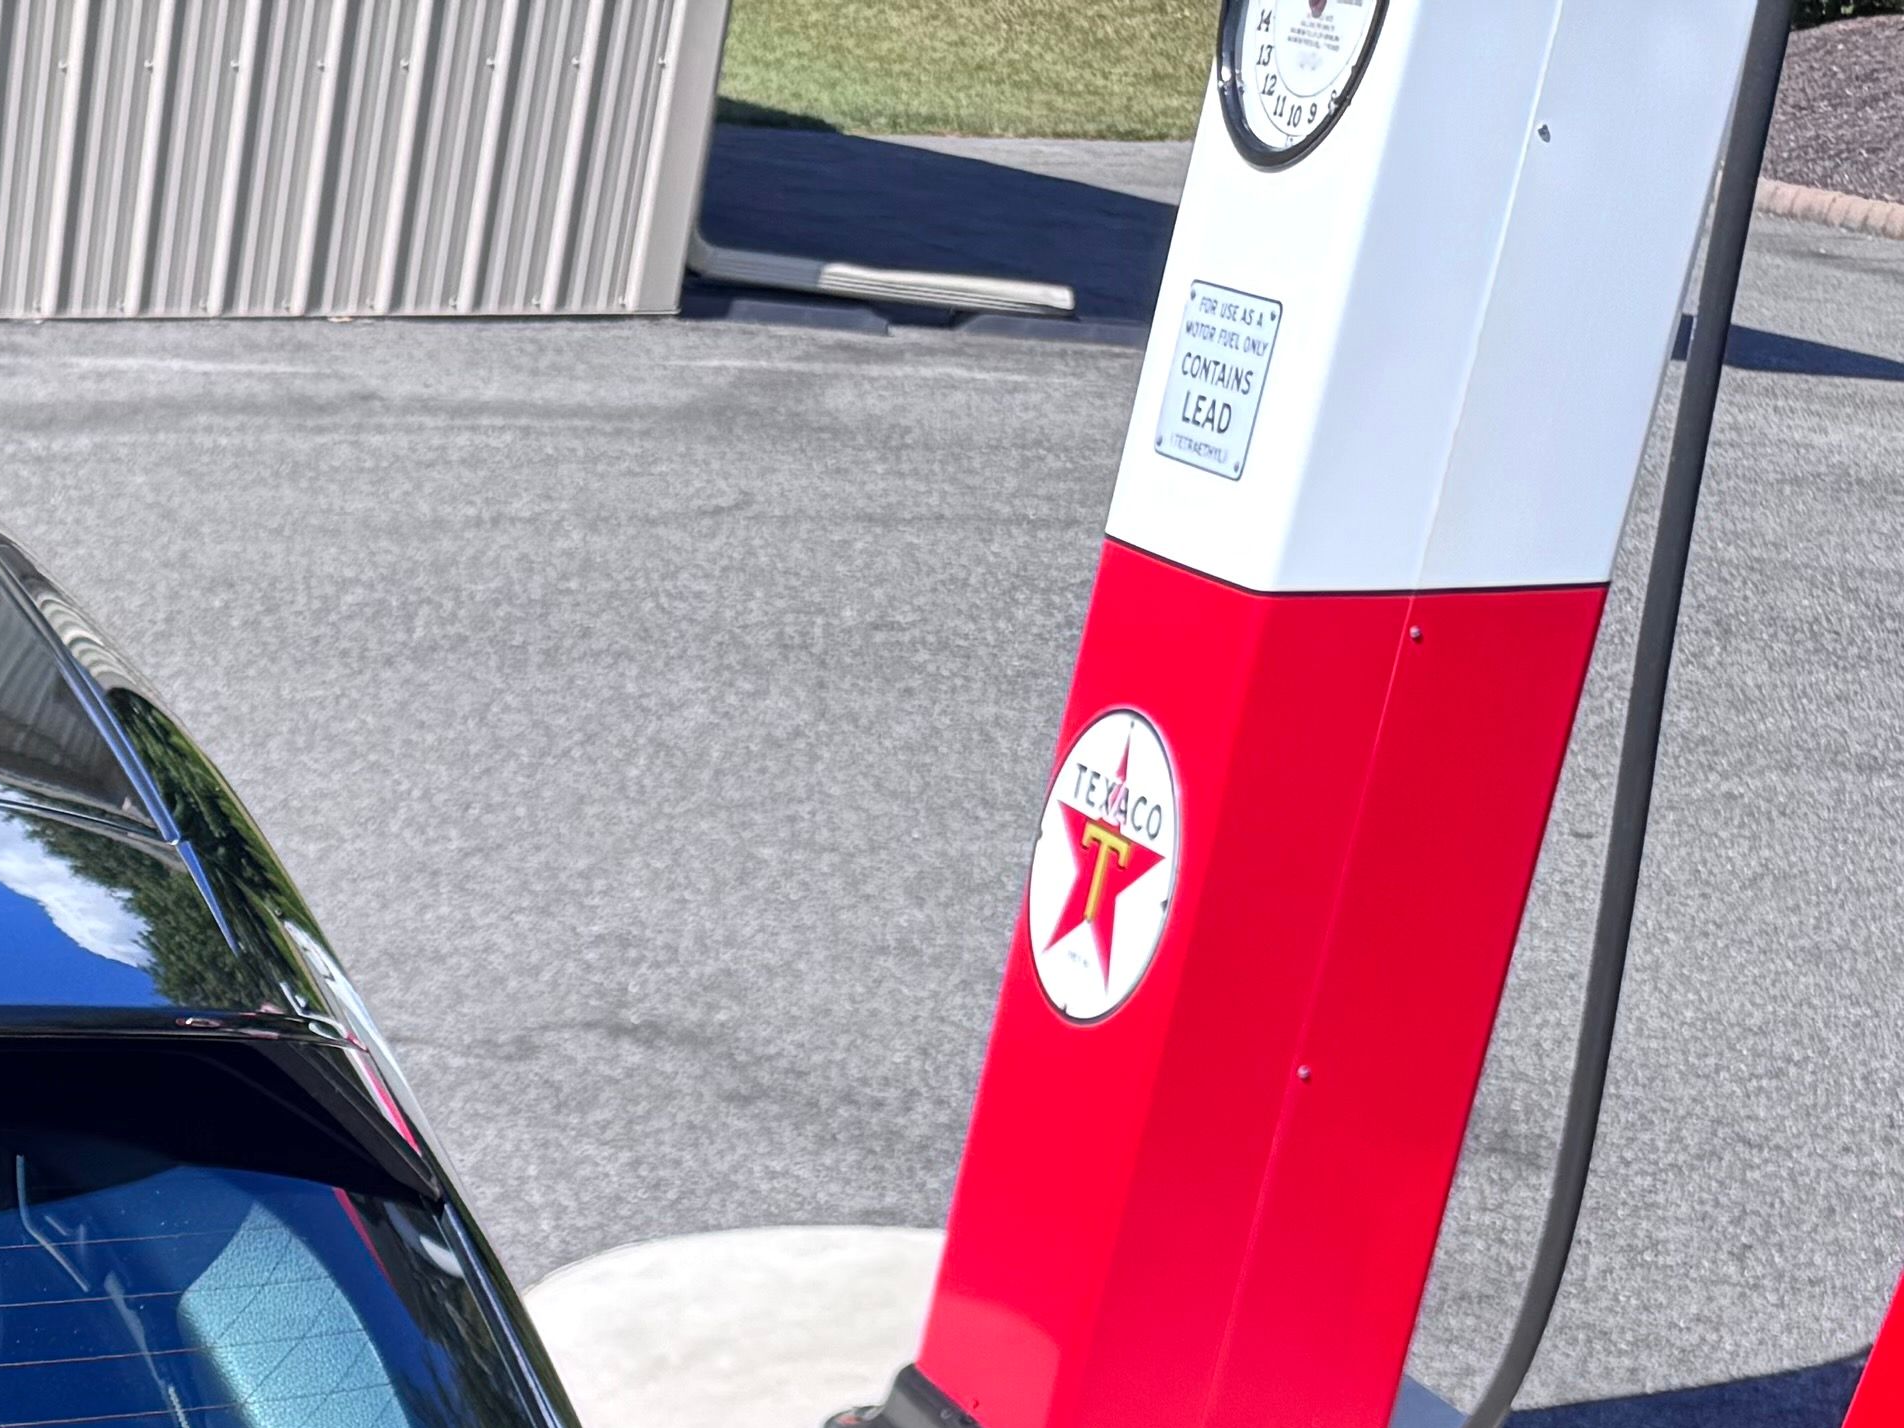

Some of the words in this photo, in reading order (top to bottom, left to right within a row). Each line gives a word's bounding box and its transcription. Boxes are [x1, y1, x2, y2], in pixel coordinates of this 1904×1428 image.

[1257, 9, 1272, 33] 14
[1256, 44, 1274, 67] 13
[1261, 73, 1278, 97] 12
[1273, 94, 1287, 118] 11
[1287, 104, 1303, 128] 10
[1307, 102, 1318, 124] 9
[1198, 296, 1219, 316] FOR
[1220, 302, 1240, 322] USE
[1240, 307, 1256, 327] AS
[1256, 312, 1264, 328] A
[1186, 320, 1217, 342] MOTOR
[1217, 328, 1241, 351] FUEL
[1243, 335, 1270, 357] ONLY
[1181, 351, 1254, 395] CONTAINS
[1181, 389, 1233, 435] LEAD
[1073, 762, 1163, 841] TEXACO
[1081, 819, 1132, 923] T
